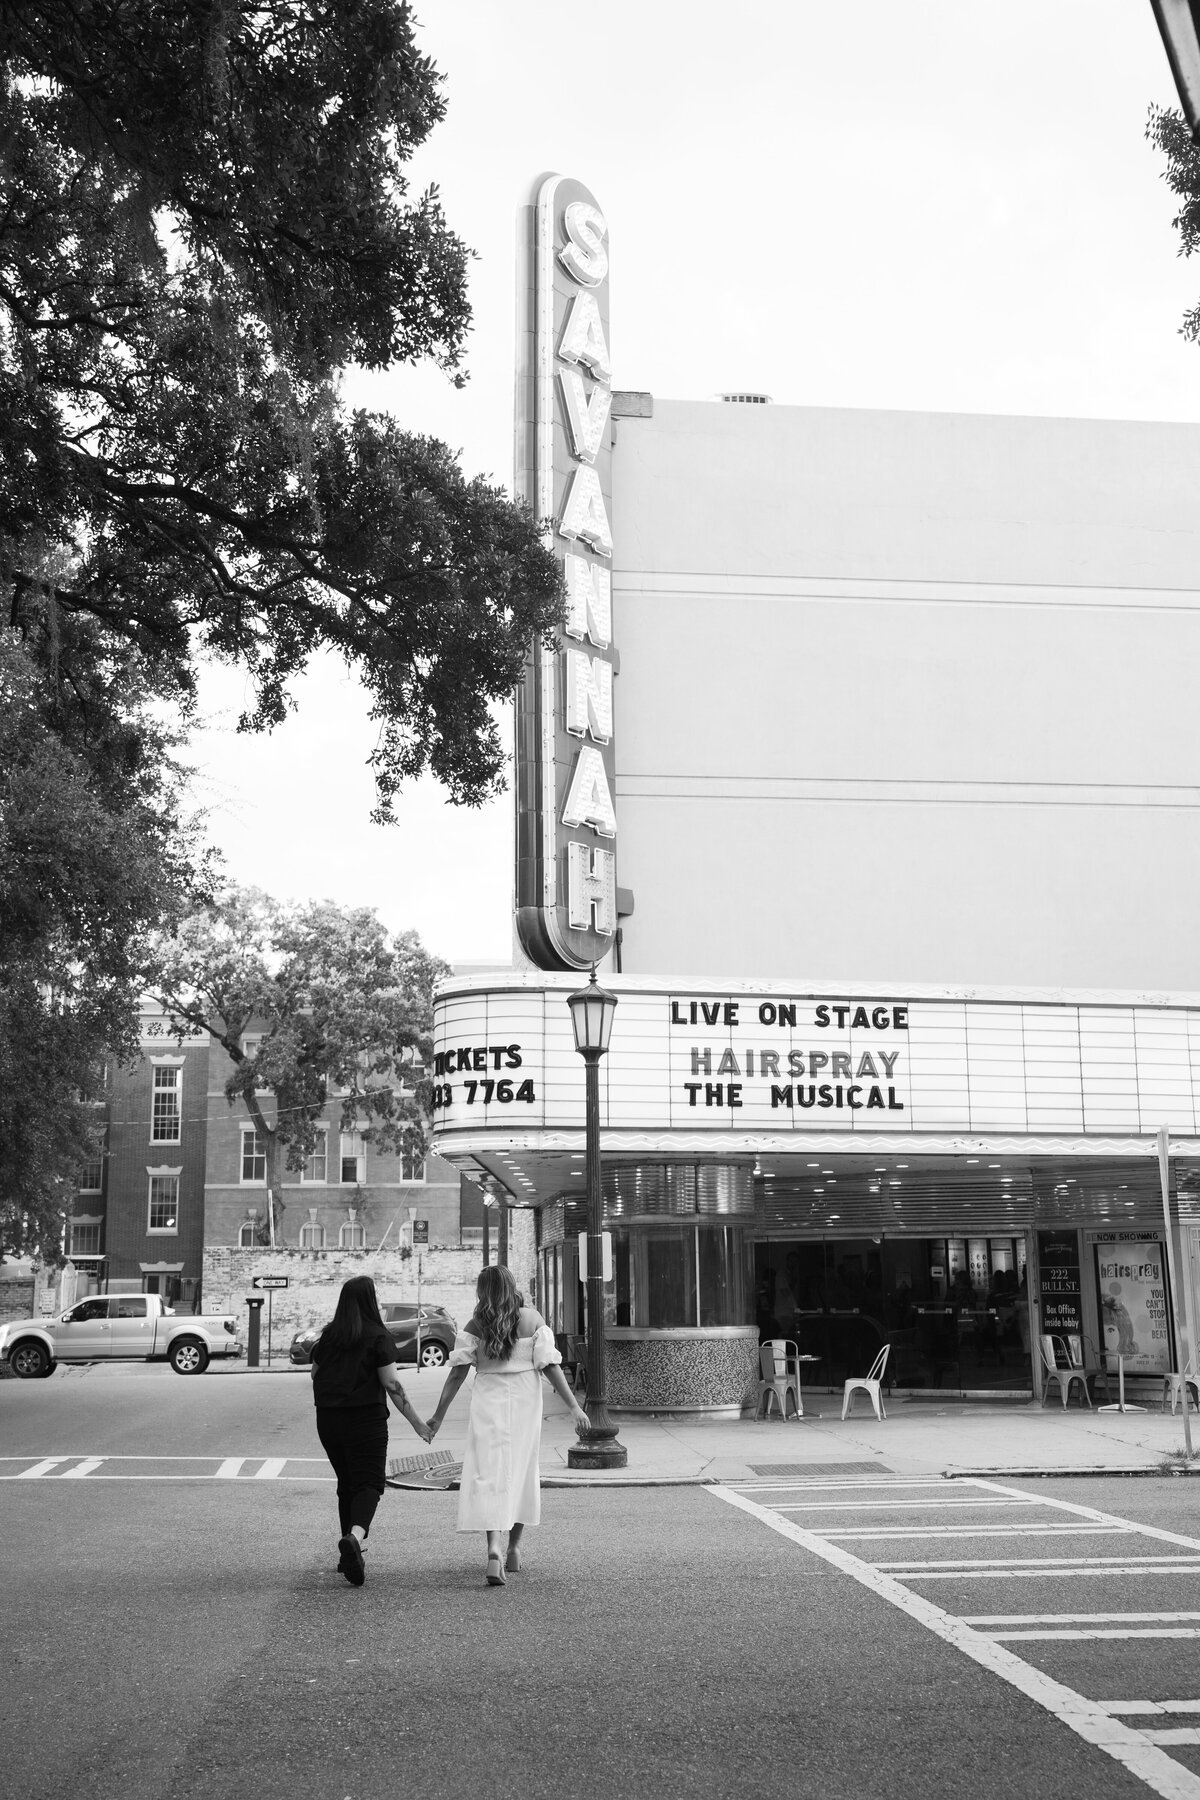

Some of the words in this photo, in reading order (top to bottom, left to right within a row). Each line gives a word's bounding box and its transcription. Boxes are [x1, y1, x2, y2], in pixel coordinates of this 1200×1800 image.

[557, 201, 618, 936] SAVANNAH
[671, 1001, 739, 1026] LIVE
[758, 1002, 797, 1027] ON
[814, 1004, 909, 1030] STAGE
[432, 1044, 522, 1077] TICKETS
[690, 1046, 900, 1079] HAIRSPRAY
[463, 1079, 536, 1105] 7764
[684, 1082, 743, 1107] THE
[770, 1084, 904, 1110] MUSICAL
[1097, 1233, 1116, 1241] NOW
[1050, 1268, 1069, 1280] 222
[1100, 1263, 1160, 1281] hairspray
[1042, 1281, 1065, 1291] BULL
[1065, 1281, 1080, 1291] ST.
[1151, 1289, 1164, 1299] YOU
[1046, 1304, 1057, 1314] Box
[1057, 1304, 1076, 1315] Office
[1146, 1299, 1165, 1309] CAN'T
[1149, 1309, 1166, 1319] STOP
[1044, 1317, 1061, 1327] inside
[1062, 1317, 1079, 1329] lobby
[1154, 1320, 1166, 1329] THE
[1151, 1330, 1167, 1339] BEAT
